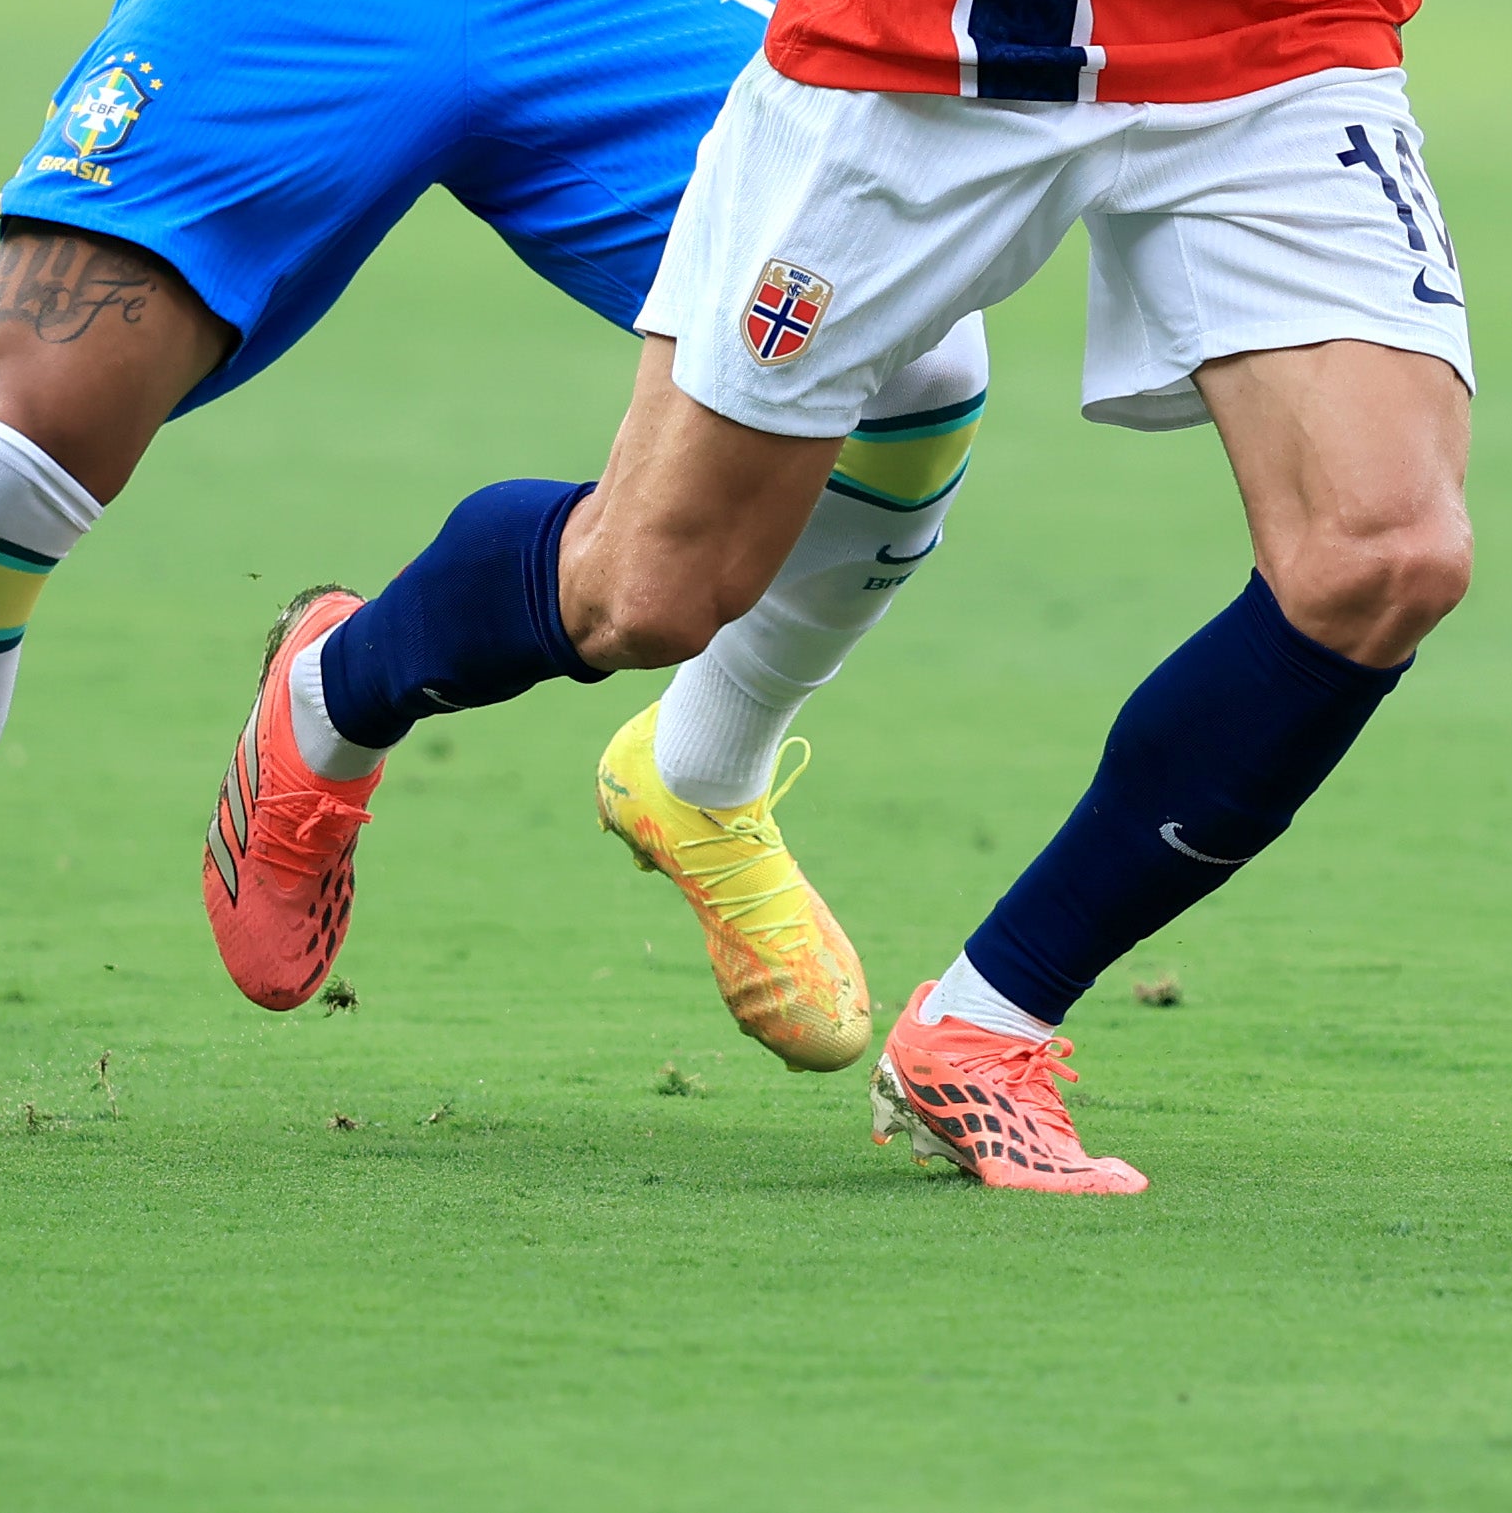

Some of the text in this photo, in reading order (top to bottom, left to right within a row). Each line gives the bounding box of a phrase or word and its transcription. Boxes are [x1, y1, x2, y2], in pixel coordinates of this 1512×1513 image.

[88, 101, 118, 116] CBF
[36, 154, 114, 187] BRASIL
[788, 268, 813, 287] NORGE
